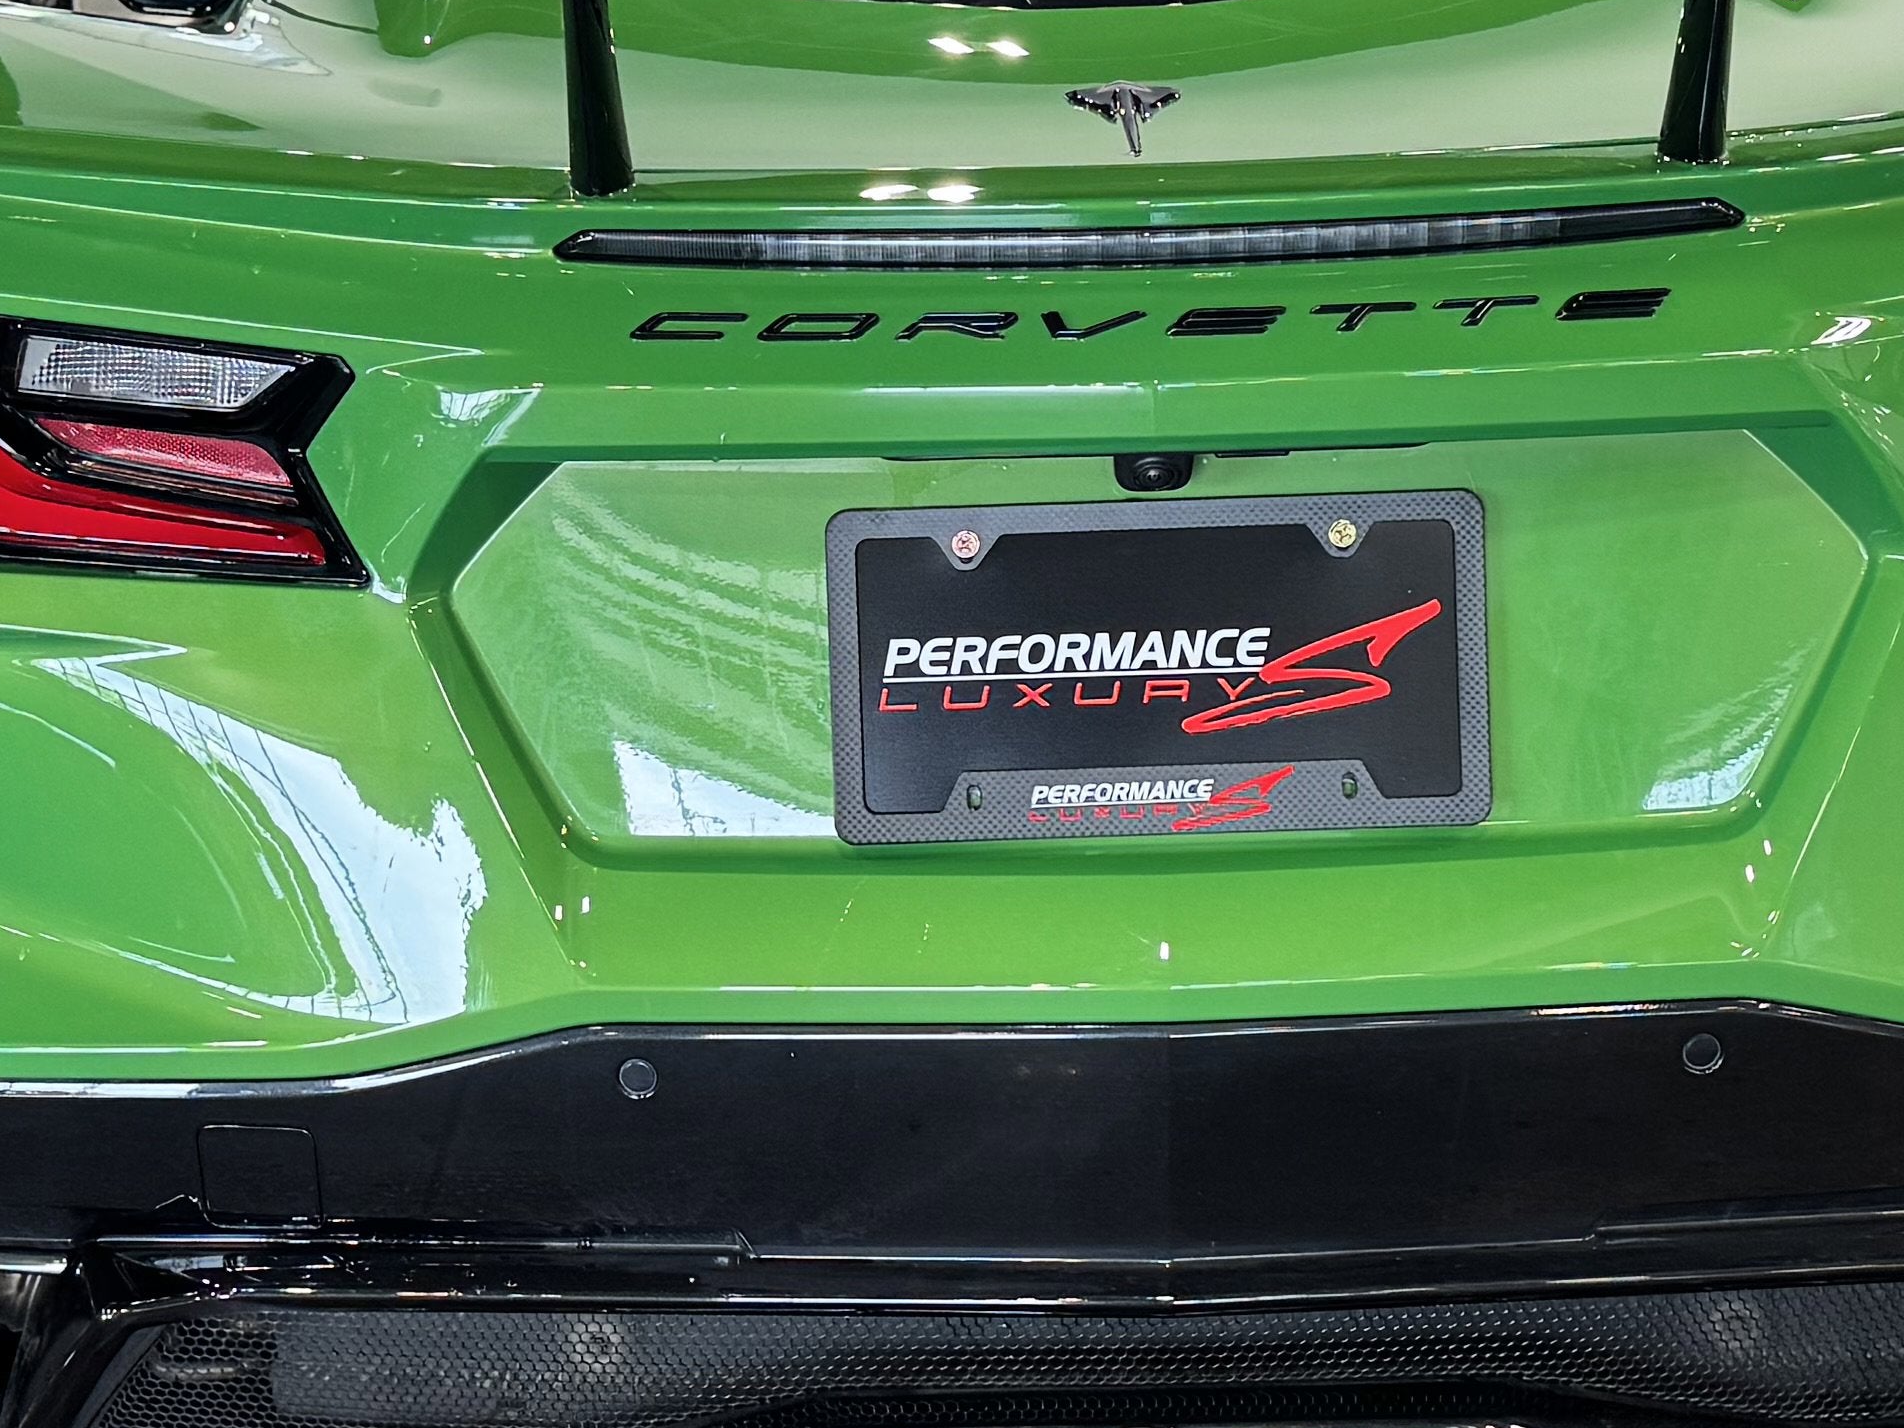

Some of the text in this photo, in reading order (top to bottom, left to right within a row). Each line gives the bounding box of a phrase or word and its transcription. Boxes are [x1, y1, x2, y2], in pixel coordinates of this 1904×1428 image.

[628, 286, 1673, 343] CORVETTE
[882, 626, 1272, 677] PERFORMANCE
[878, 676, 1257, 713] LUXURY
[1030, 778, 1215, 805] PERFORMANCE
